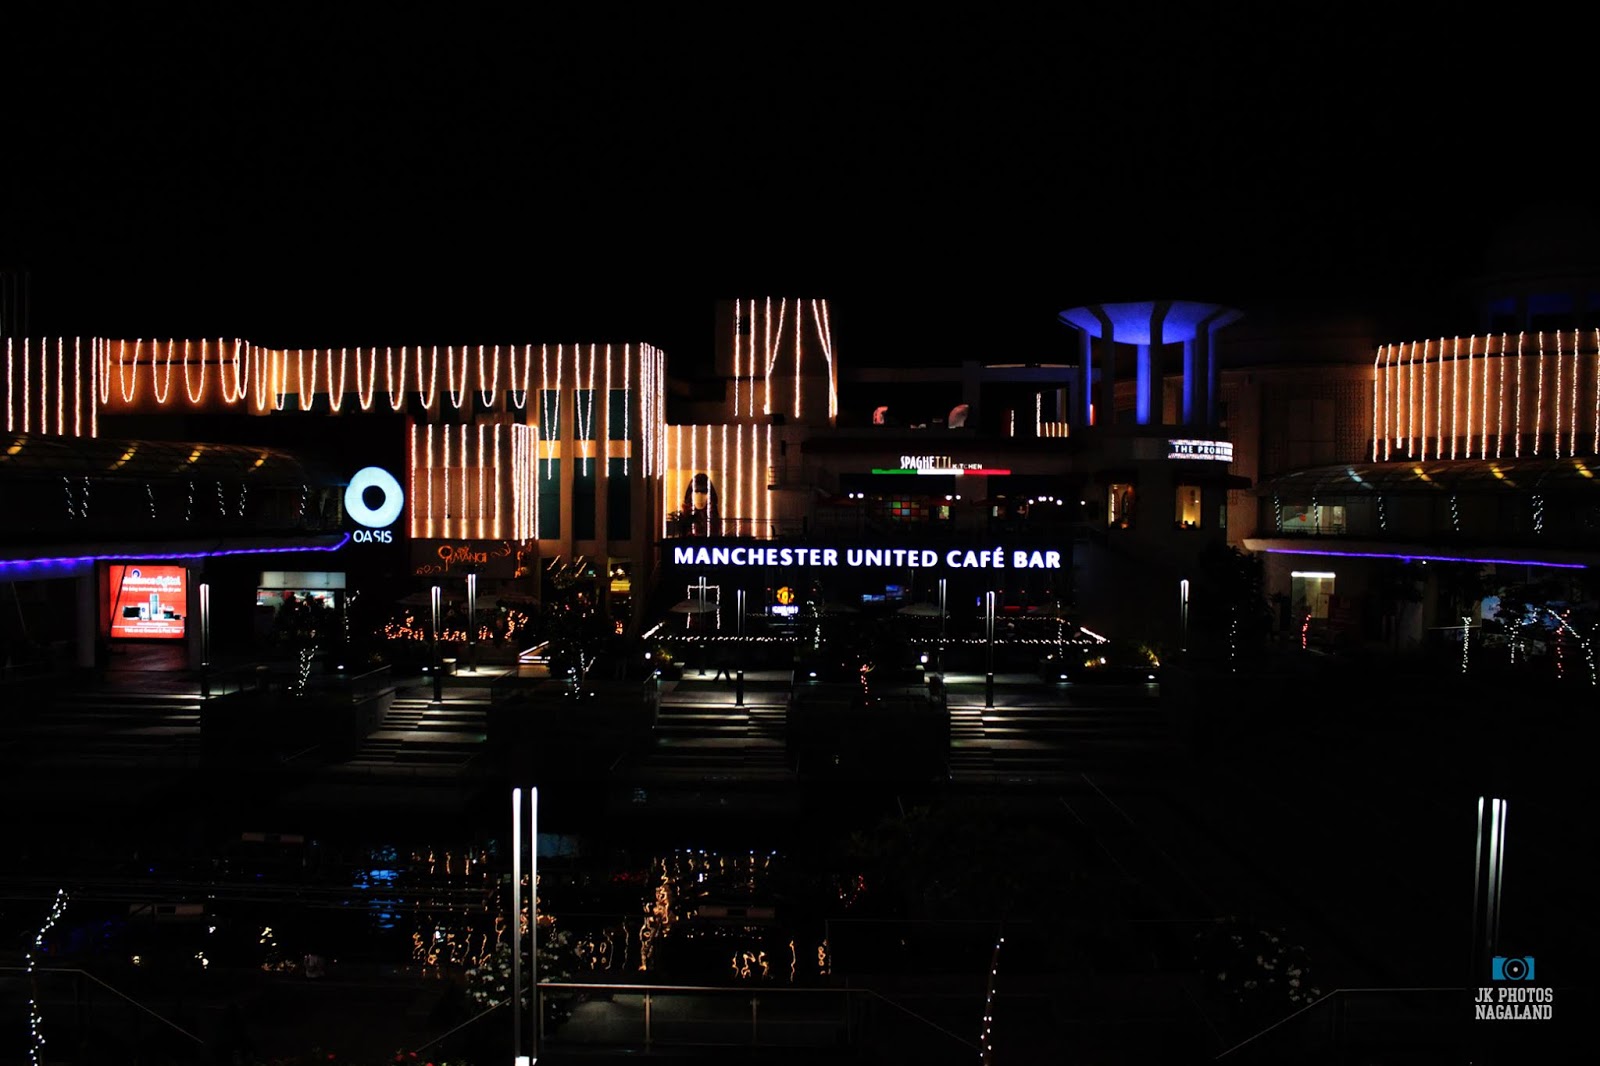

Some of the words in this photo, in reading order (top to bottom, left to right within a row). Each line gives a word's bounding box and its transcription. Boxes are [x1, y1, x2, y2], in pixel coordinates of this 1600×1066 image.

[1175, 445, 1193, 453] THE
[900, 455, 951, 469] SPAGHETTI
[353, 530, 393, 544] OASIS
[674, 547, 838, 567] MANCHESTER
[847, 548, 938, 568] UNITED
[947, 547, 1005, 568] CAFÉ
[1013, 550, 1061, 569] BAR
